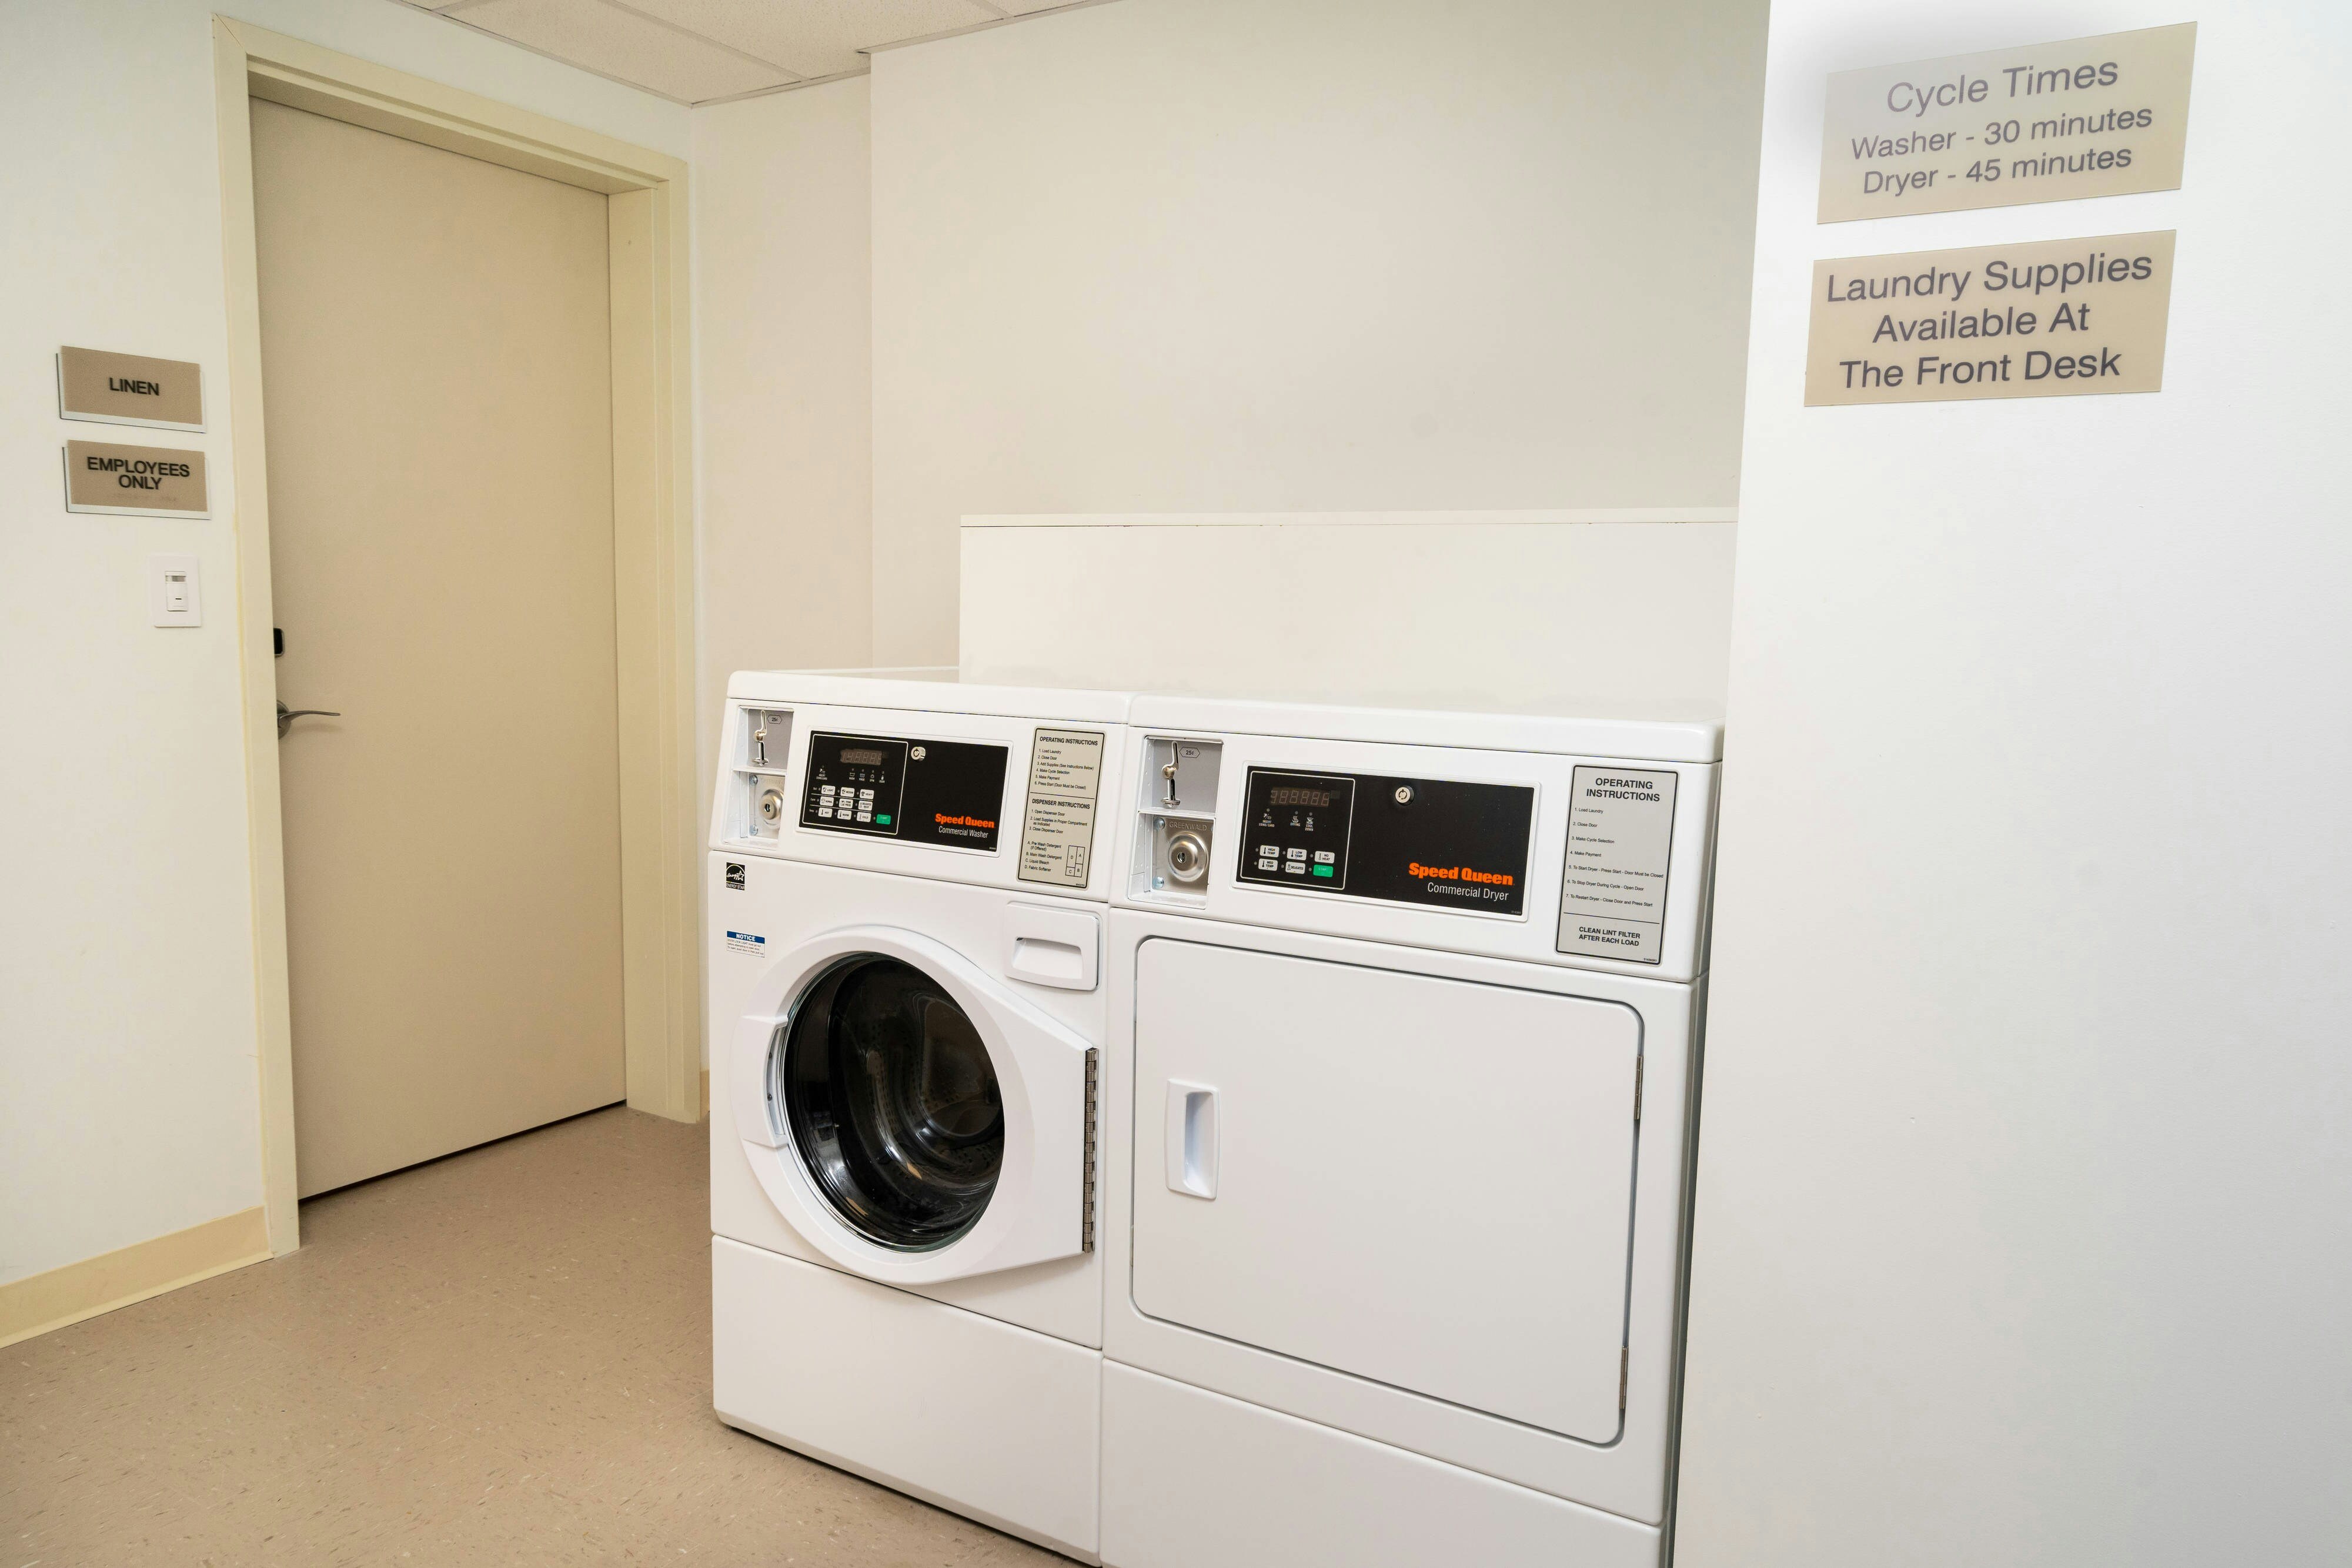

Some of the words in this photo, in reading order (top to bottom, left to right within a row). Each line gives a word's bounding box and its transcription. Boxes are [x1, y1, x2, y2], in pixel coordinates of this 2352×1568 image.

[1887, 75, 1989, 117] Cycle
[2002, 61, 2118, 98] Times
[1850, 130, 1956, 161] Washer
[1984, 119, 2020, 145] 30
[2030, 108, 2153, 141] minutes
[1863, 168, 1938, 196] Dryer
[1966, 159, 2001, 183] 45
[2012, 148, 2132, 179] minutes
[1827, 266, 1971, 303] Laundry
[1984, 253, 2152, 295] Supplies
[1872, 307, 2036, 343] Available
[2049, 303, 2090, 333] At
[1839, 360, 1904, 389] The
[1917, 354, 2012, 385] Front
[2024, 347, 2122, 380] Desk
[109, 377, 160, 396] LINEN
[87, 456, 190, 477] EMPLOYEES
[119, 474, 162, 489] ONLY
[1595, 778, 1653, 789] OPERATING
[1586, 789, 1660, 801] INSTRUCTIONS
[935, 813, 964, 825] Speed
[965, 817, 994, 828] Queen
[1169, 821, 1207, 831] GREENWALD
[938, 826, 968, 836] Commercial
[970, 830, 988, 838] Washer
[1408, 862, 1459, 880] Speed
[1461, 867, 1513, 885] Queen
[1428, 882, 1481, 897] Commercial
[1484, 888, 1509, 902] Dryer
